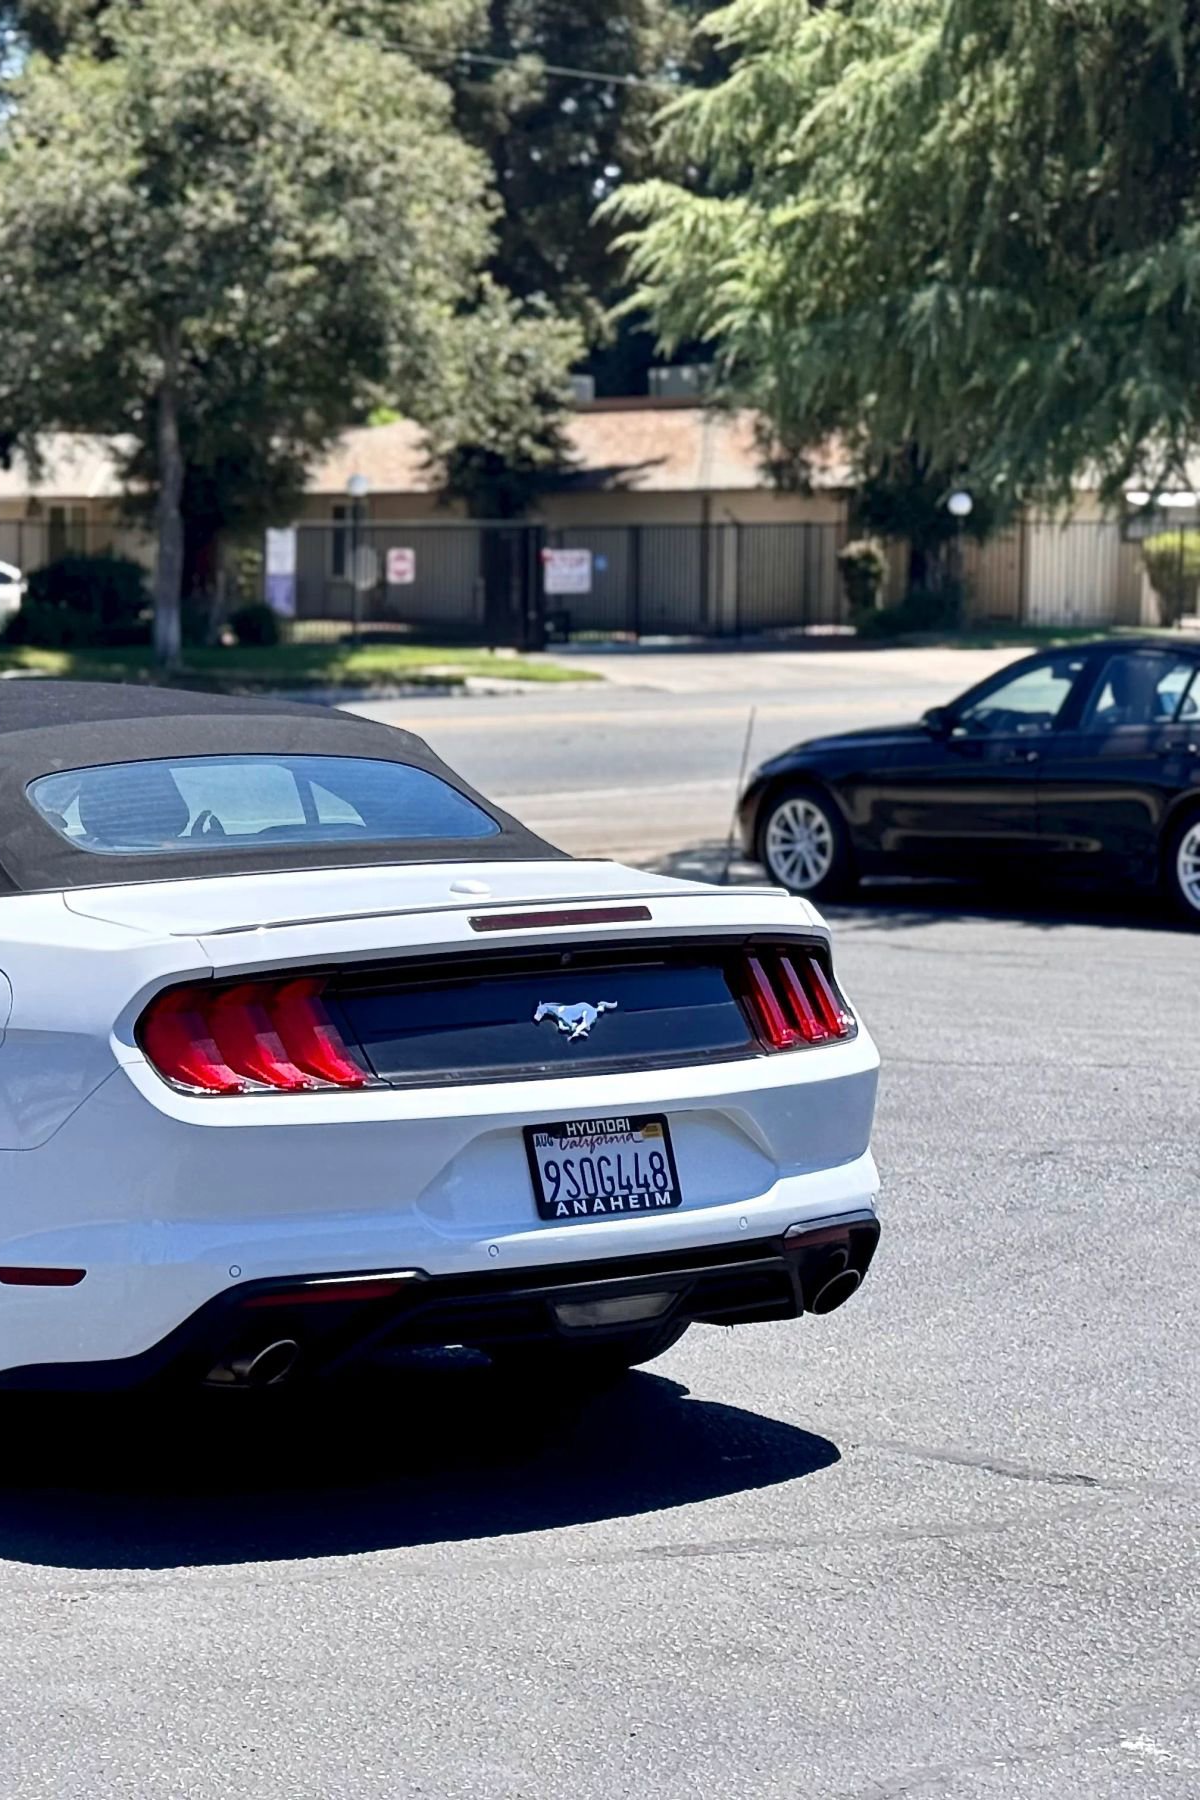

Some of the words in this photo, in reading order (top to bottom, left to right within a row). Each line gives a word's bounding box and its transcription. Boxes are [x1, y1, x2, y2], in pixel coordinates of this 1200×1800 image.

[566, 1118, 631, 1137] HYUNDAI
[535, 1133, 554, 1148] AUG
[558, 1132, 644, 1154] California
[544, 1151, 669, 1202] 9SOG448
[556, 1191, 672, 1217] ANAHEIM
